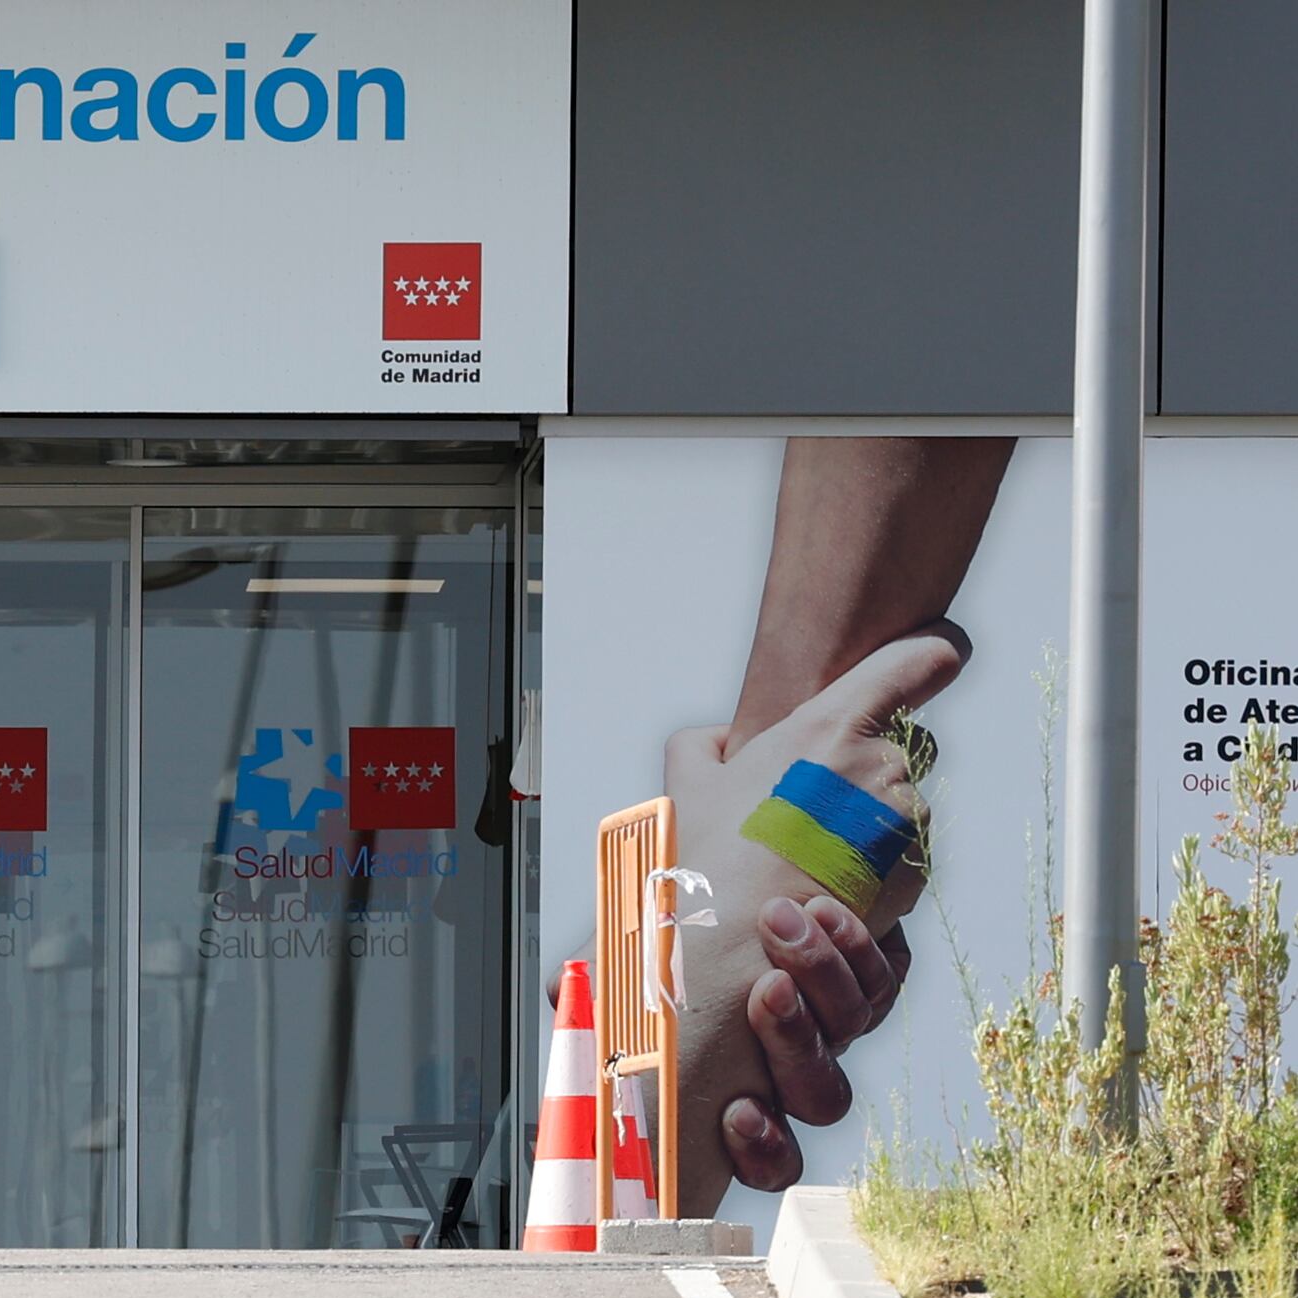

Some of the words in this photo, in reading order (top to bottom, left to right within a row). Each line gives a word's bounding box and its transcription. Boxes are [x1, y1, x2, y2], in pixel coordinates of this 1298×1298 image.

[381, 350, 482, 364] Comunidad
[381, 368, 404, 383] de
[412, 368, 481, 384] Madrid
[1183, 697, 1228, 724] de
[1182, 741, 1204, 762] a
[234, 845, 460, 879] SaludMadrid
